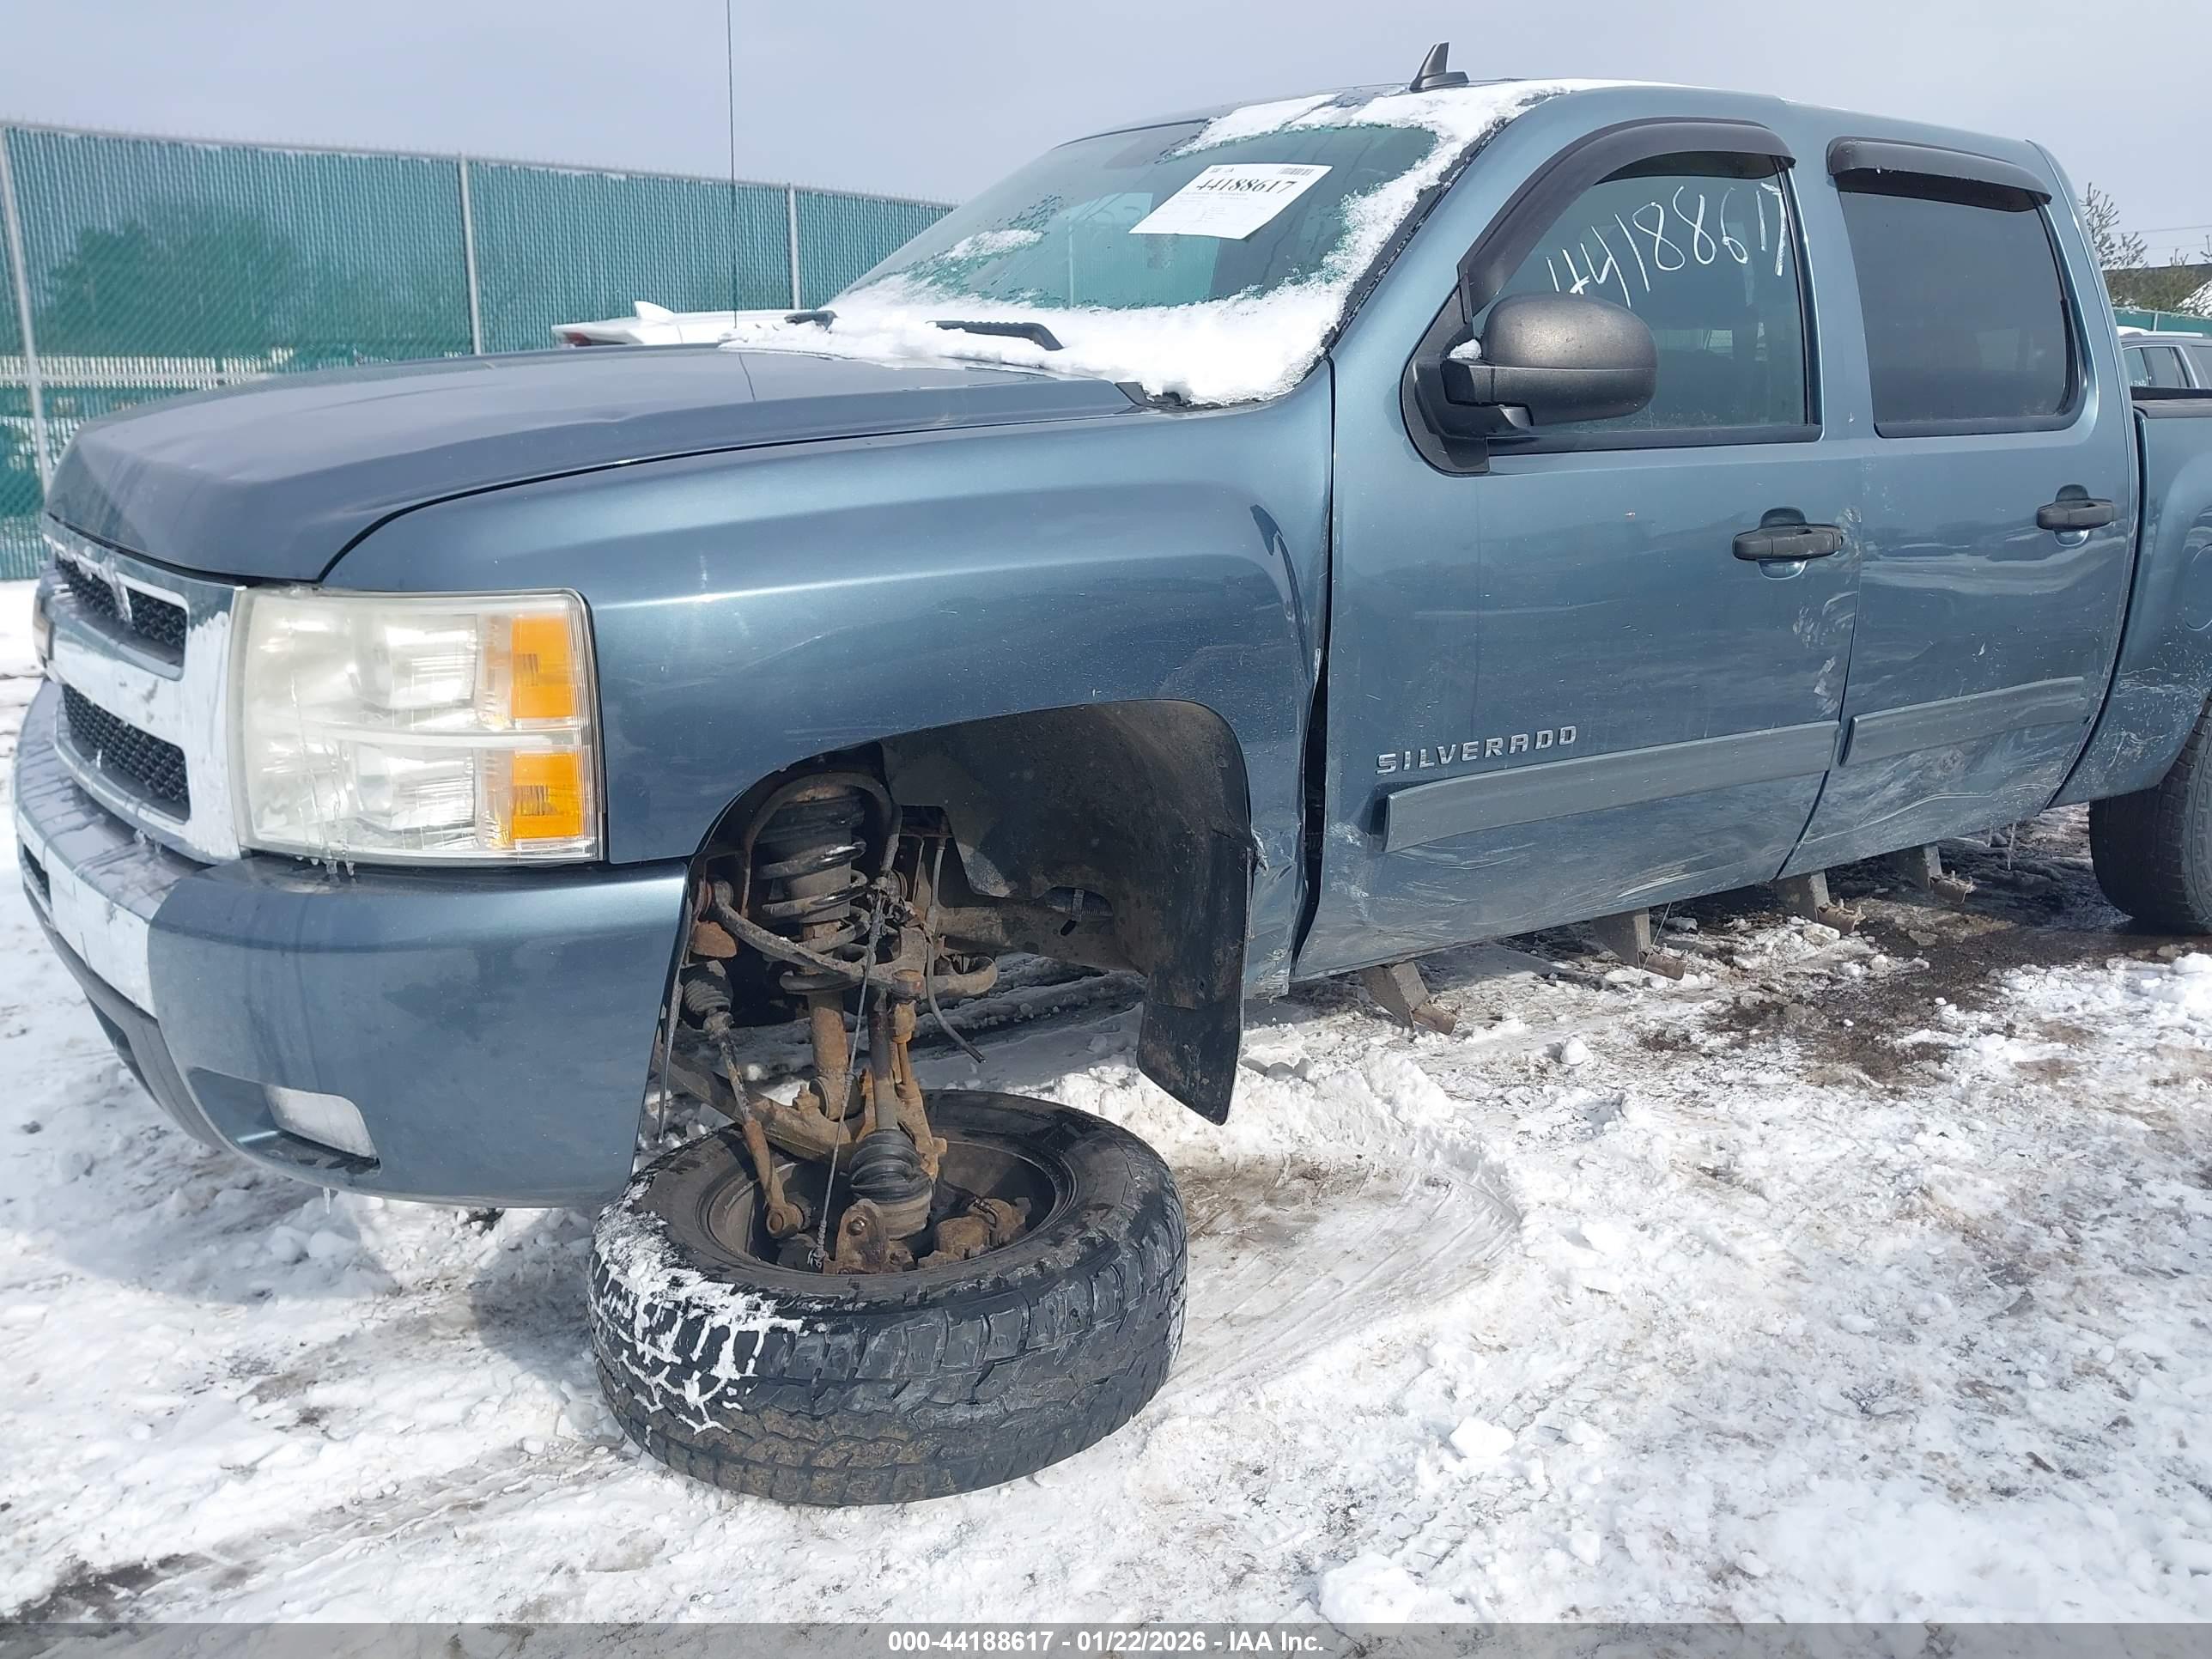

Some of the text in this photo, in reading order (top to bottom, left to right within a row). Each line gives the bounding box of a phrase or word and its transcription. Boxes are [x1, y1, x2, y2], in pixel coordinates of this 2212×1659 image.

[1196, 178, 1298, 194] 44188617
[1545, 181, 1786, 310] 44188617
[1376, 725, 1577, 775] SILVERADO
